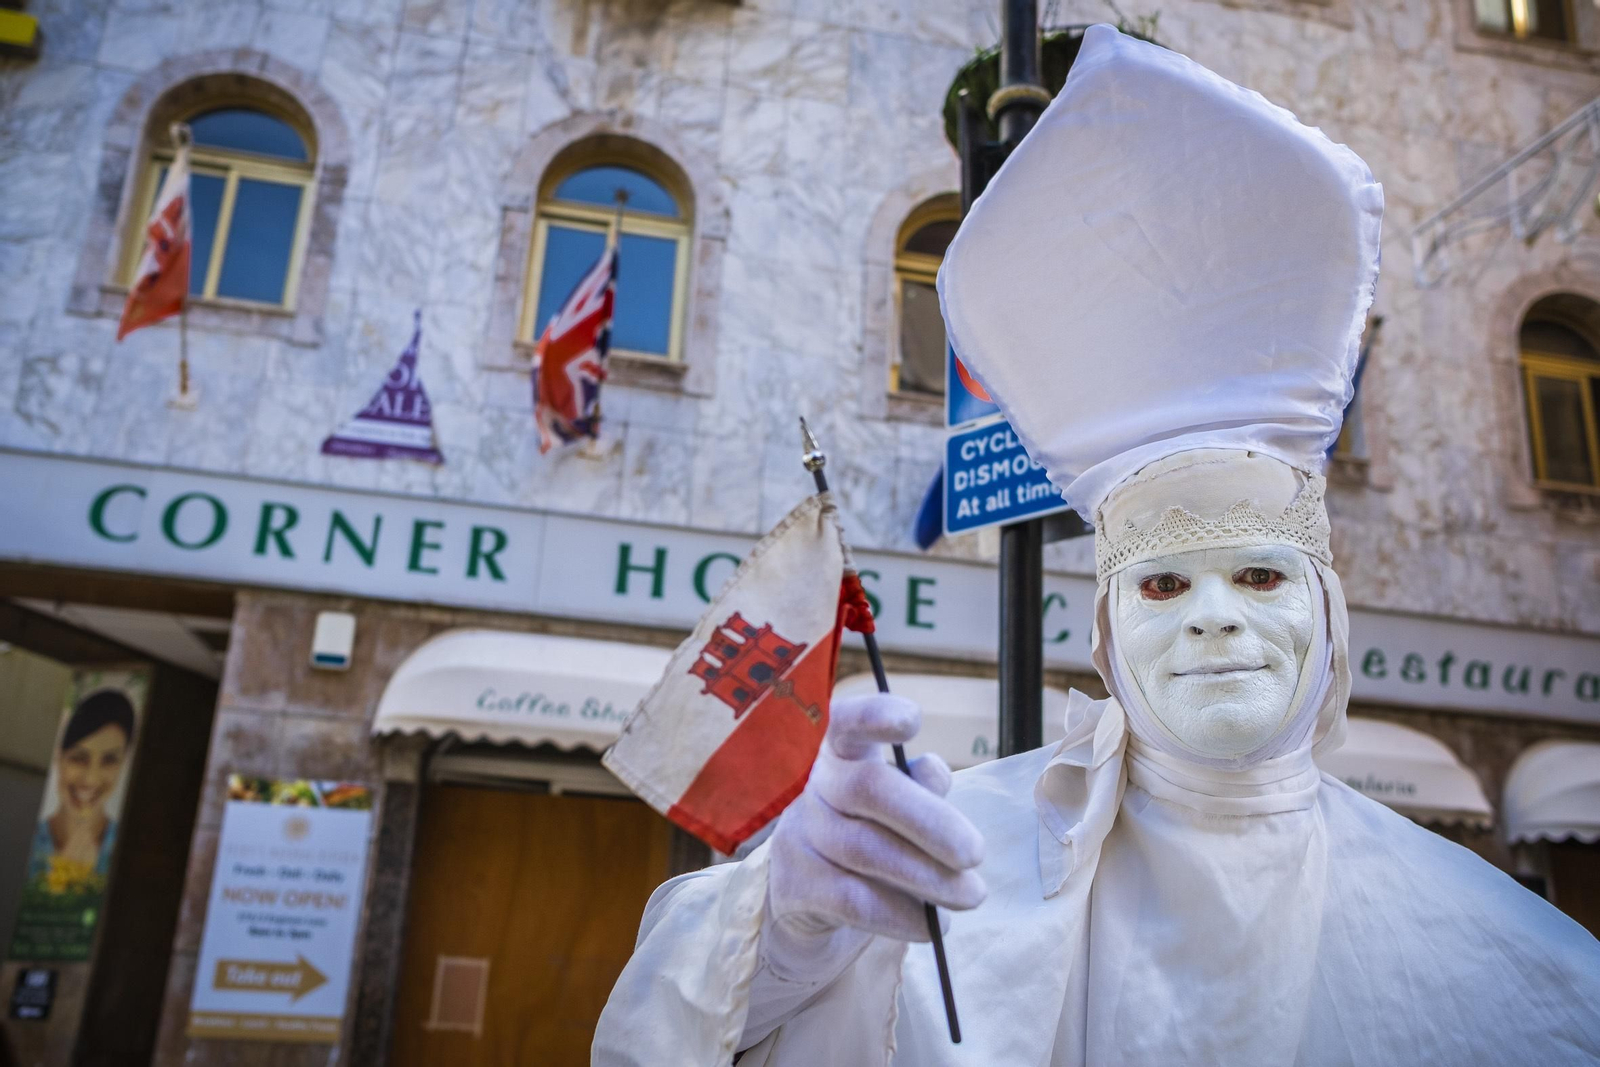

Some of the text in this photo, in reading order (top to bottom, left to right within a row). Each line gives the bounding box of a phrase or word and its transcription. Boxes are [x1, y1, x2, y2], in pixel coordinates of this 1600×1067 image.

[960, 430, 1021, 461] CYCL
[956, 496, 981, 519] At
[985, 488, 1011, 512] all
[88, 484, 509, 582] CORNER
[613, 542, 937, 630] HOSE
[475, 687, 570, 718] Coffee
